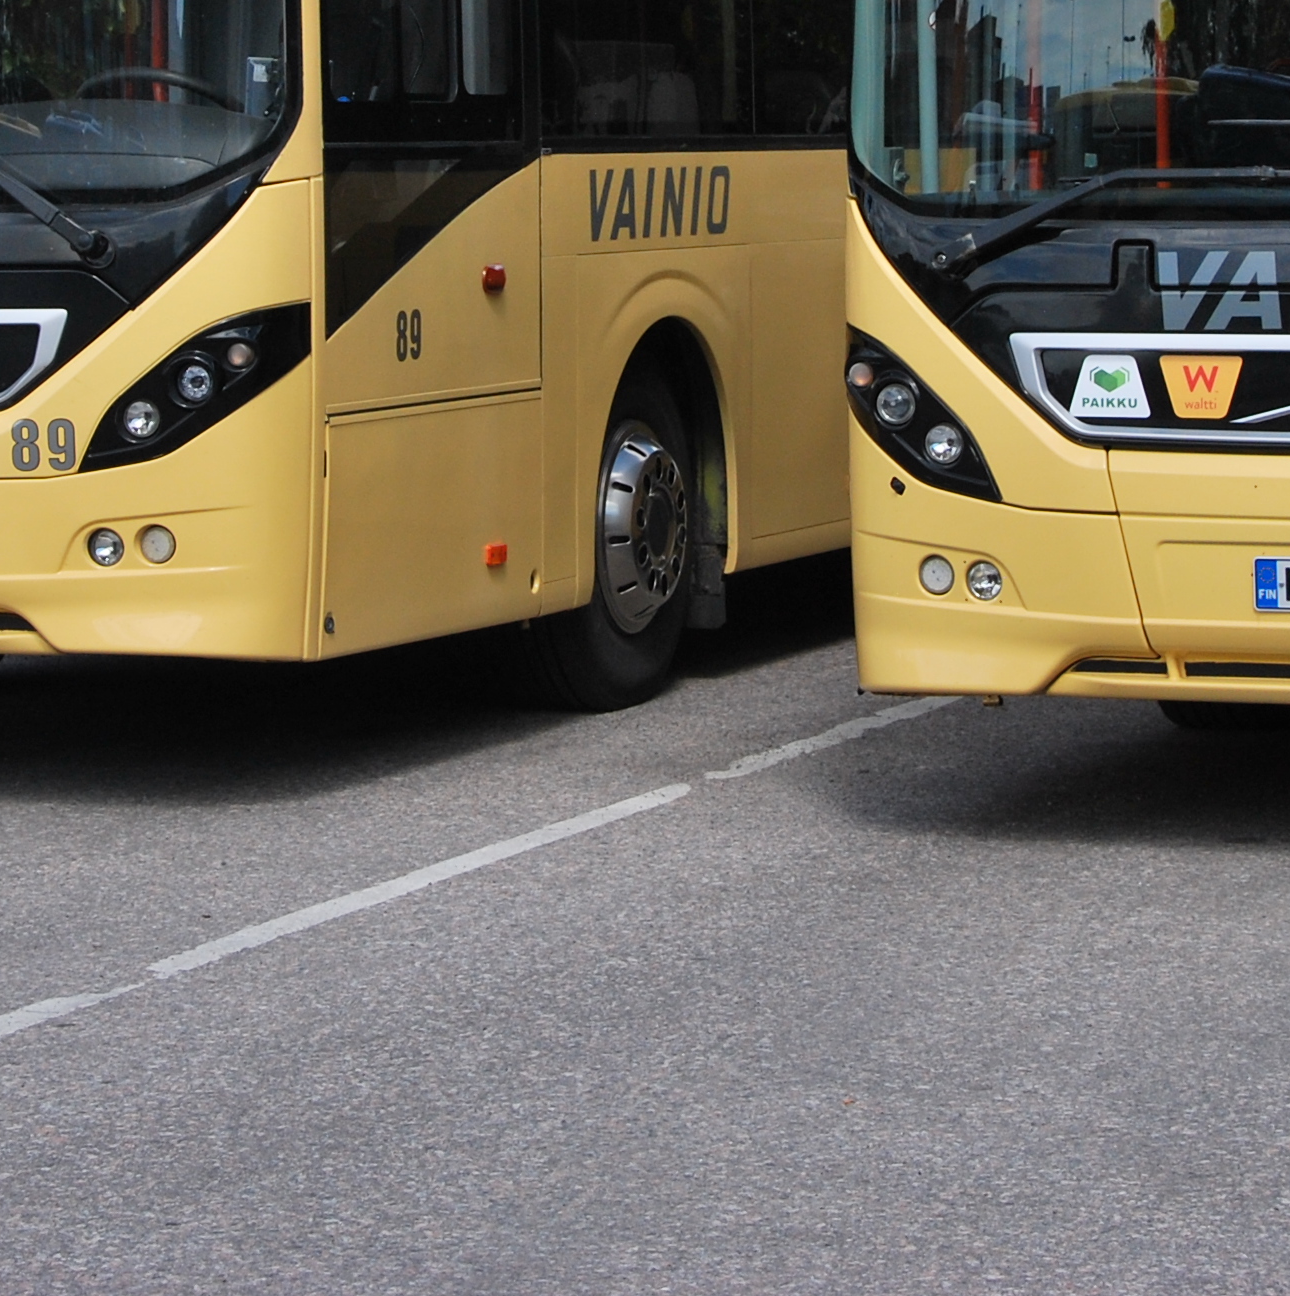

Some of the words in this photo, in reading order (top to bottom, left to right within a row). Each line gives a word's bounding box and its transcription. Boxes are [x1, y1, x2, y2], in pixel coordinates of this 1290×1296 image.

[589, 165, 731, 242] VAINIO
[396, 308, 422, 362] 89
[1182, 365, 1219, 394] W
[1082, 396, 1139, 410] PAIKKU
[1184, 397, 1218, 411] waltti
[11, 418, 76, 472] 89
[1258, 588, 1277, 600] FIN
